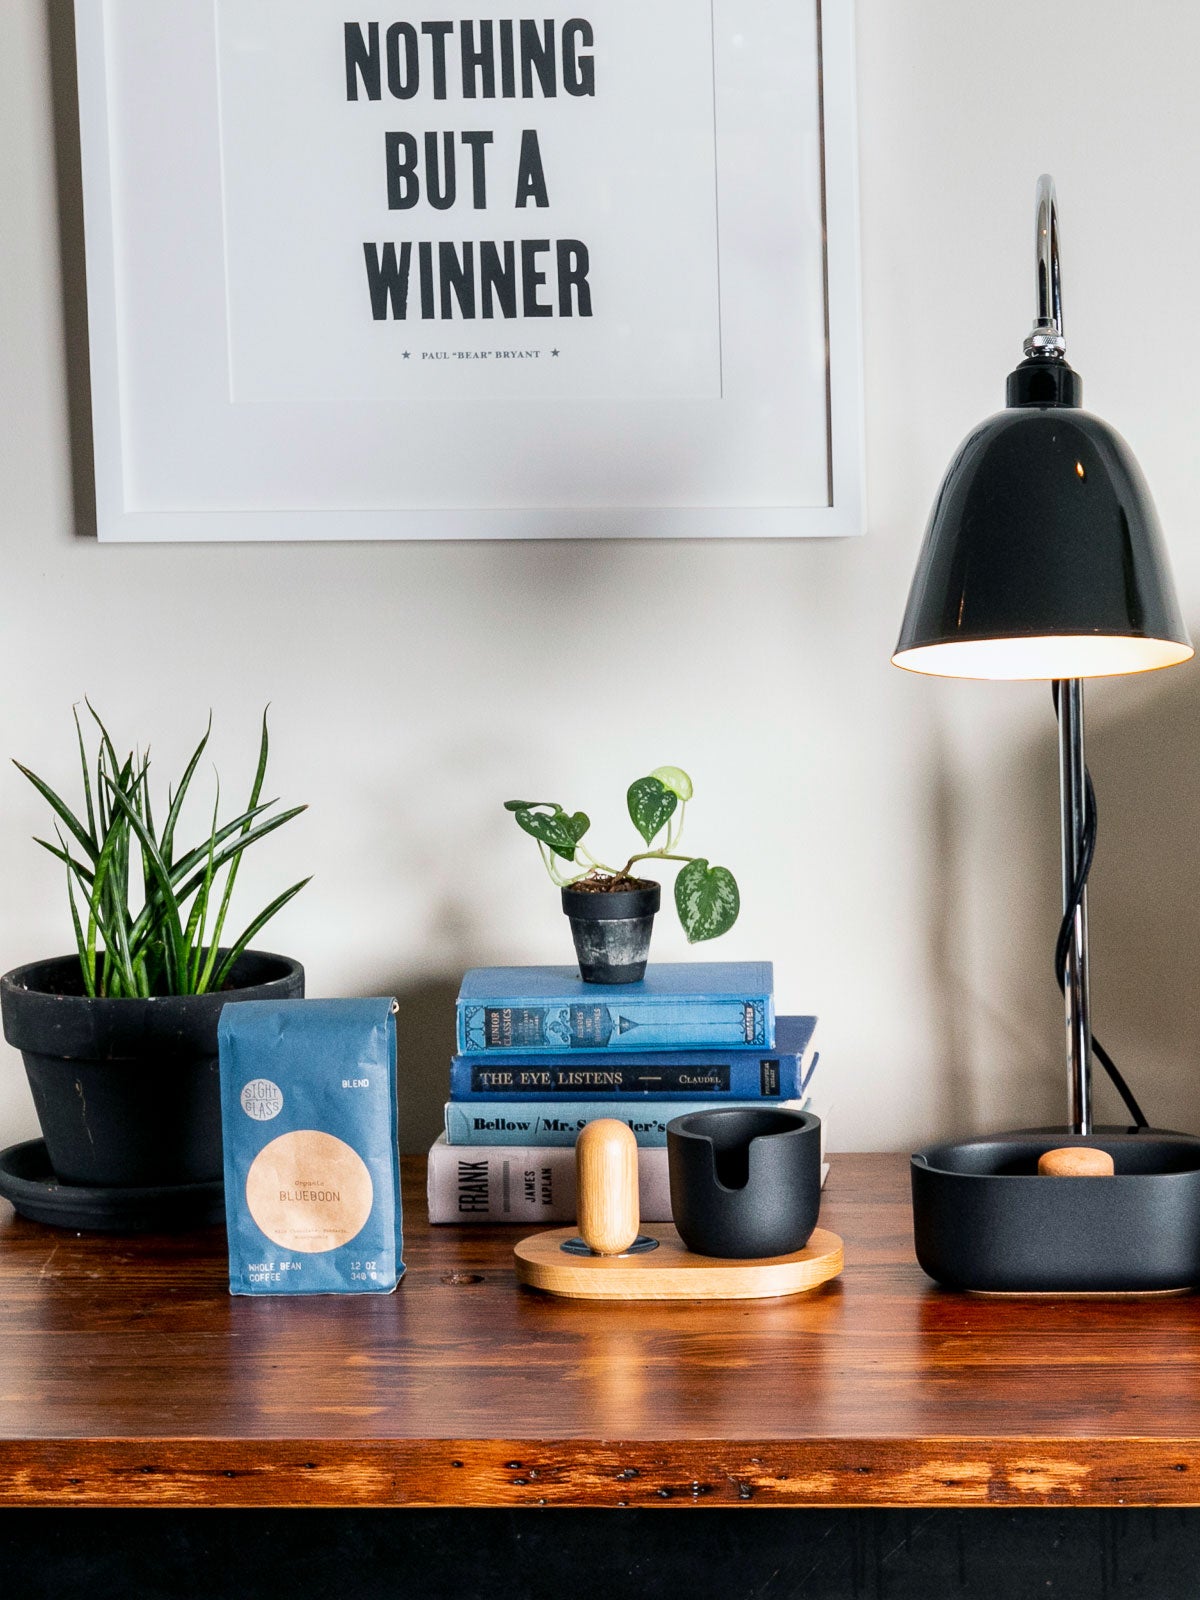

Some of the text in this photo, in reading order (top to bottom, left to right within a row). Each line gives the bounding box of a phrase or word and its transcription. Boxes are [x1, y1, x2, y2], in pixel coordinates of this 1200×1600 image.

[344, 18, 595, 101] NOTHING
[385, 129, 550, 210] BUT A
[363, 239, 593, 320] WINNER
[422, 352, 449, 360] PAUL
[495, 350, 541, 358] BRYANT
[491, 1012, 502, 1045] JUNIOR
[503, 1008, 512, 1047] CLASSICS
[342, 1079, 369, 1088] BLEND
[480, 1072, 514, 1085] THE
[520, 1072, 551, 1085] EYE
[557, 1072, 623, 1084] LISTENS
[244, 1081, 278, 1099] SIGHT
[246, 1101, 279, 1119] GLASS
[473, 1118, 531, 1132] Bellow
[543, 1119, 574, 1131] Mr.
[279, 1190, 341, 1201] BLUEBOON
[458, 1161, 489, 1212] FRANK
[525, 1170, 536, 1203] JAMES
[542, 1168, 553, 1205] KAPLAN
[249, 1262, 302, 1272] WHOLE BEAN
[351, 1261, 377, 1270] 12 OZ
[249, 1273, 281, 1282] COFFEE
